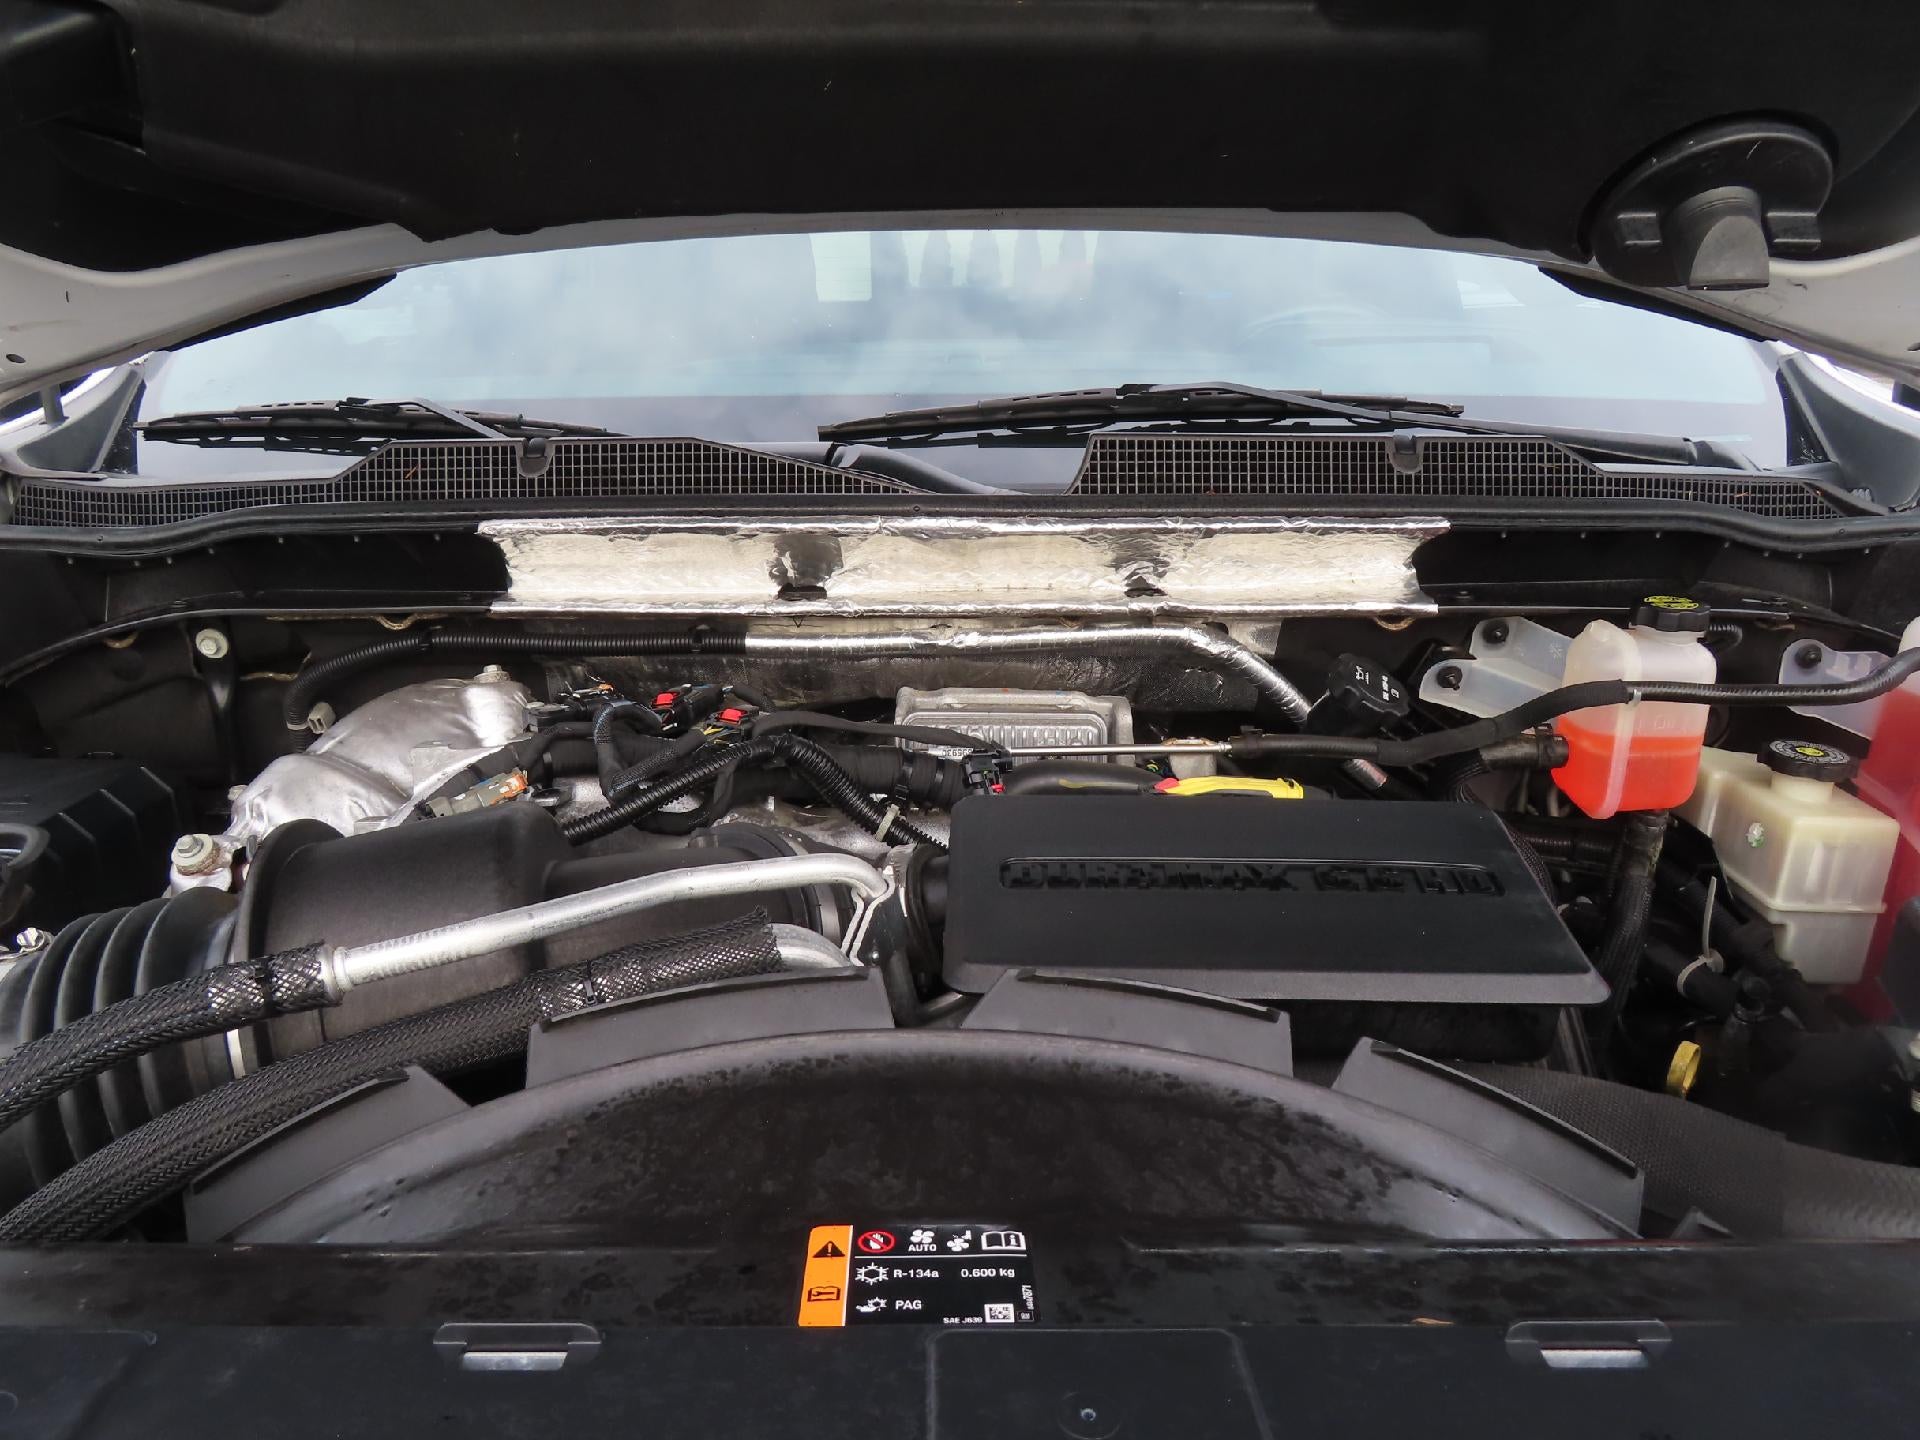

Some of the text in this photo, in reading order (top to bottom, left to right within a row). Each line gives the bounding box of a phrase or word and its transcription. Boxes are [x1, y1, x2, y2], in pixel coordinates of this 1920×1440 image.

[908, 1243, 937, 1252] AUTO
[893, 1267, 1016, 1278] R-134a 0.600 kg
[895, 1300, 922, 1310] PAG
[943, 1316, 961, 1324] SAE
